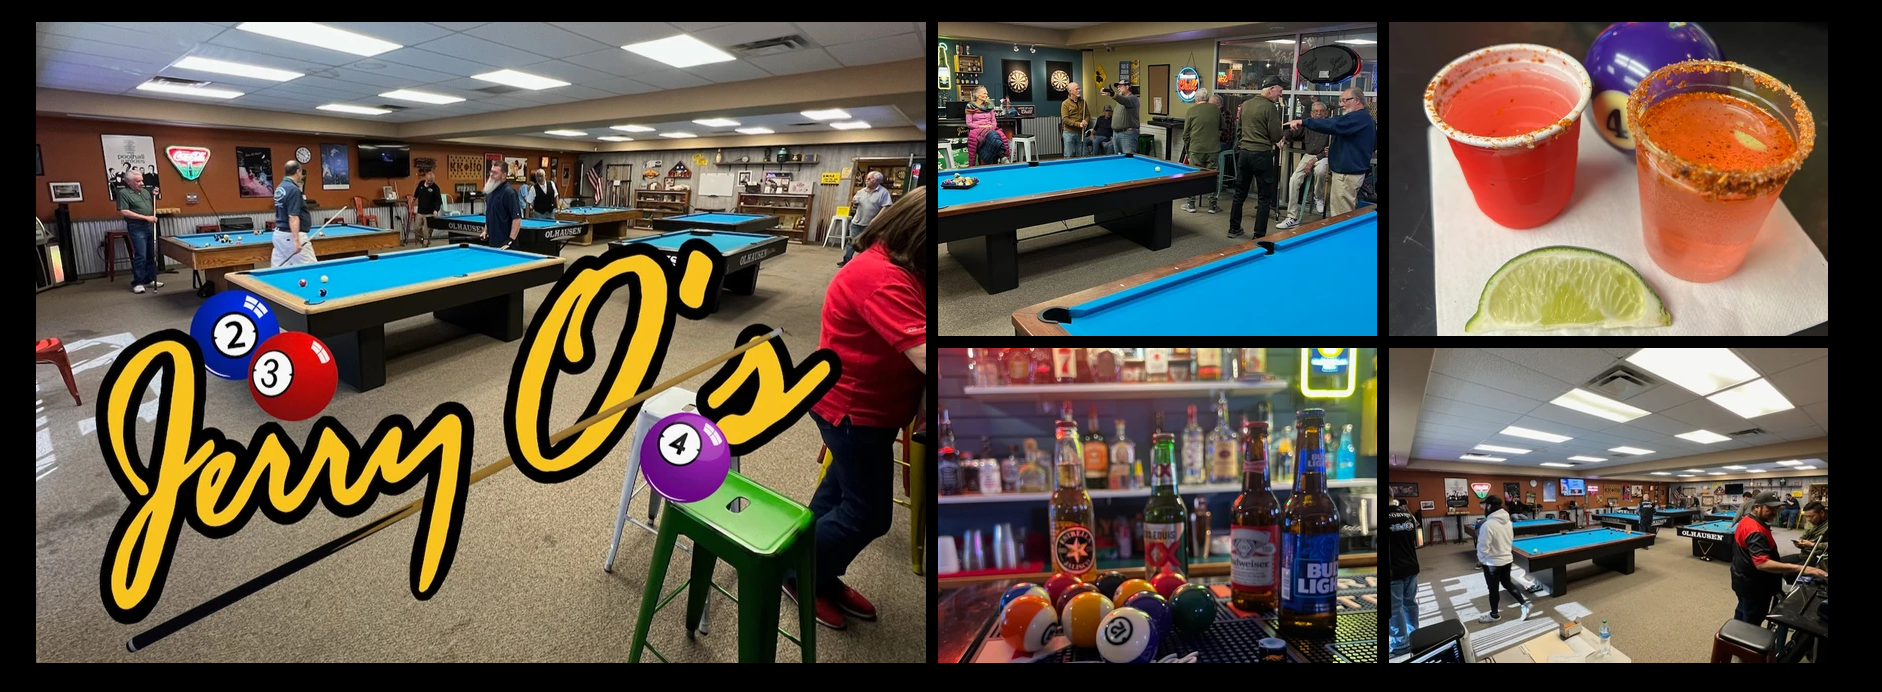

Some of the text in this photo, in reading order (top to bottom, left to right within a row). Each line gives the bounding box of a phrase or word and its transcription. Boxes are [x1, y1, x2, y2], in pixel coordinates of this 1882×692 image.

[1606, 108, 1629, 139] 4
[117, 153, 145, 161] poolhall
[544, 227, 583, 239] OLHAUSEN
[739, 248, 768, 266] OLHAUSEN
[1153, 530, 1176, 540] EQUIS
[1681, 529, 1724, 542] OLHAUSEN
